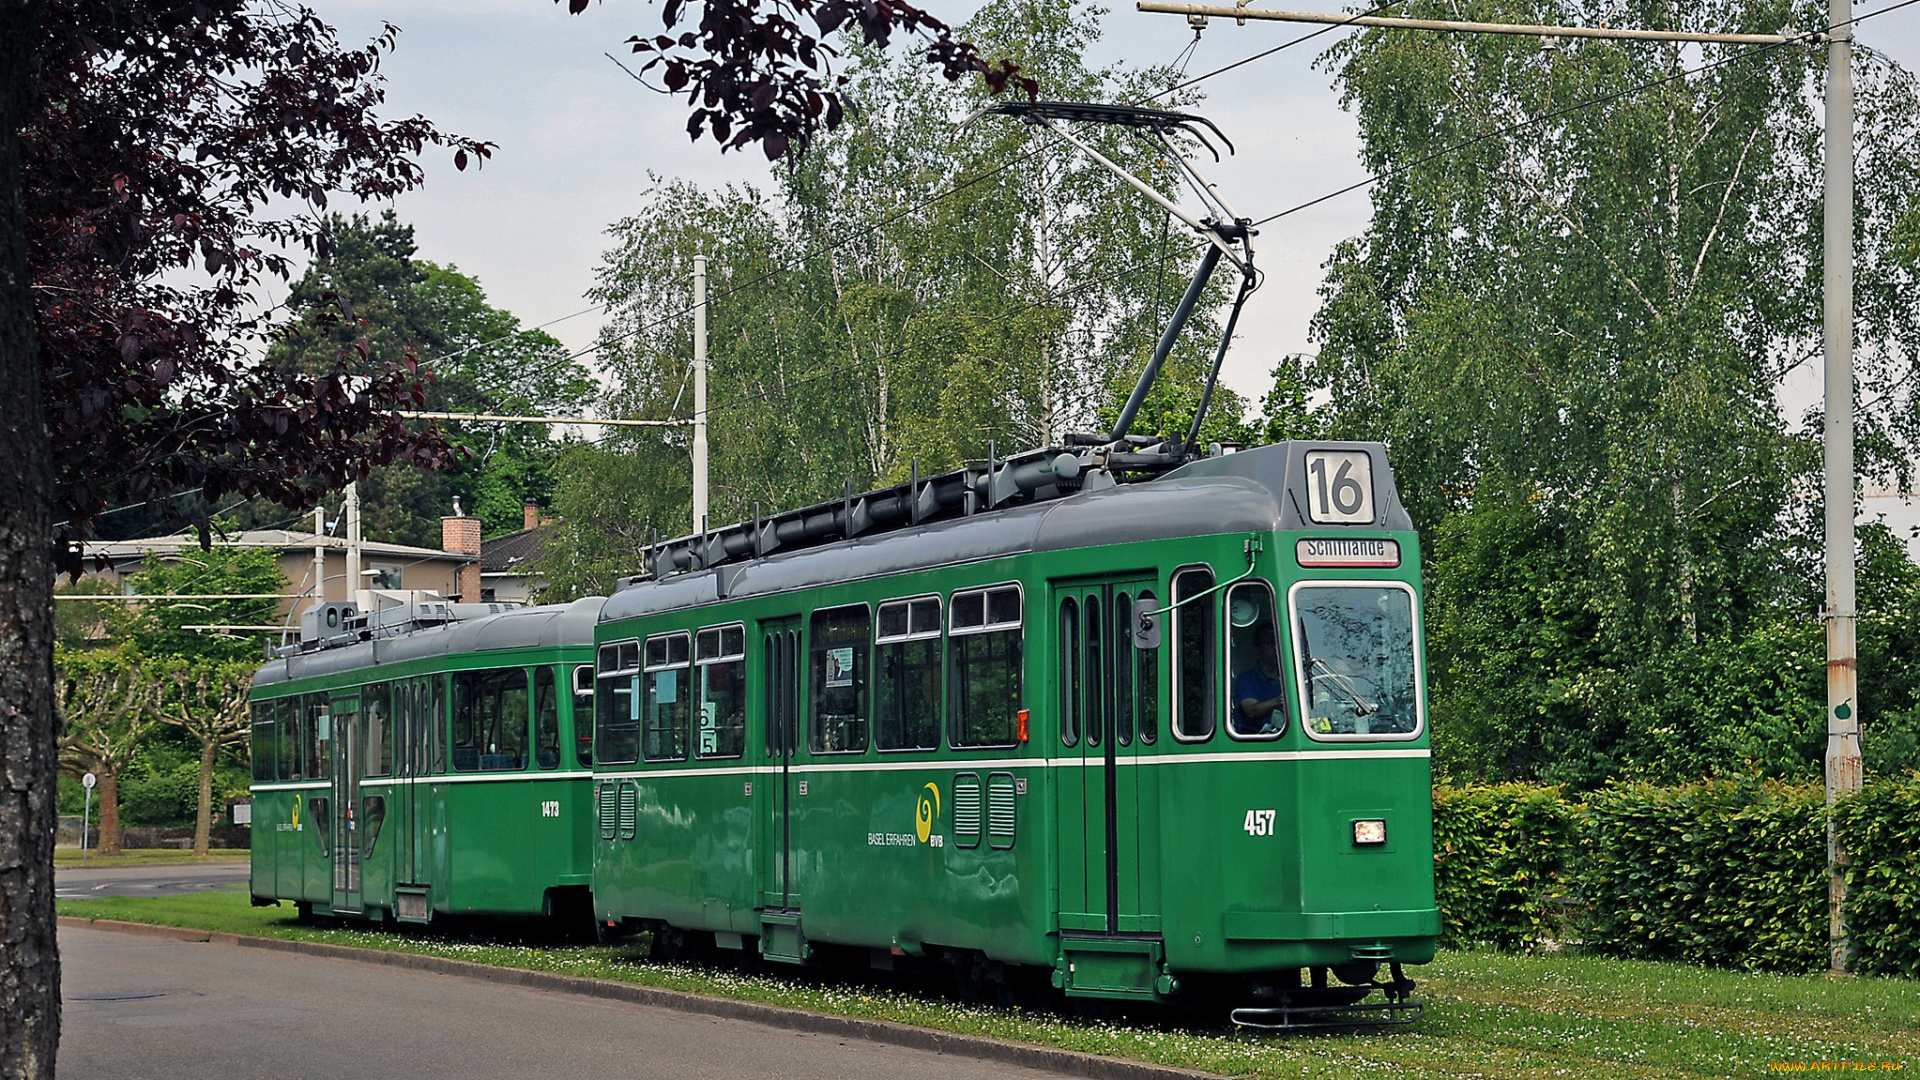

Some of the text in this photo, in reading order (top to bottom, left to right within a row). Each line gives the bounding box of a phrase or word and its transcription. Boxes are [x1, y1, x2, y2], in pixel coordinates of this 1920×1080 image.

[1310, 458, 1364, 515] 16
[541, 801, 560, 817] 1473
[1244, 810, 1276, 836] 457
[867, 833, 916, 846] BASEL ERFAHREN
[930, 835, 943, 847] BVB
